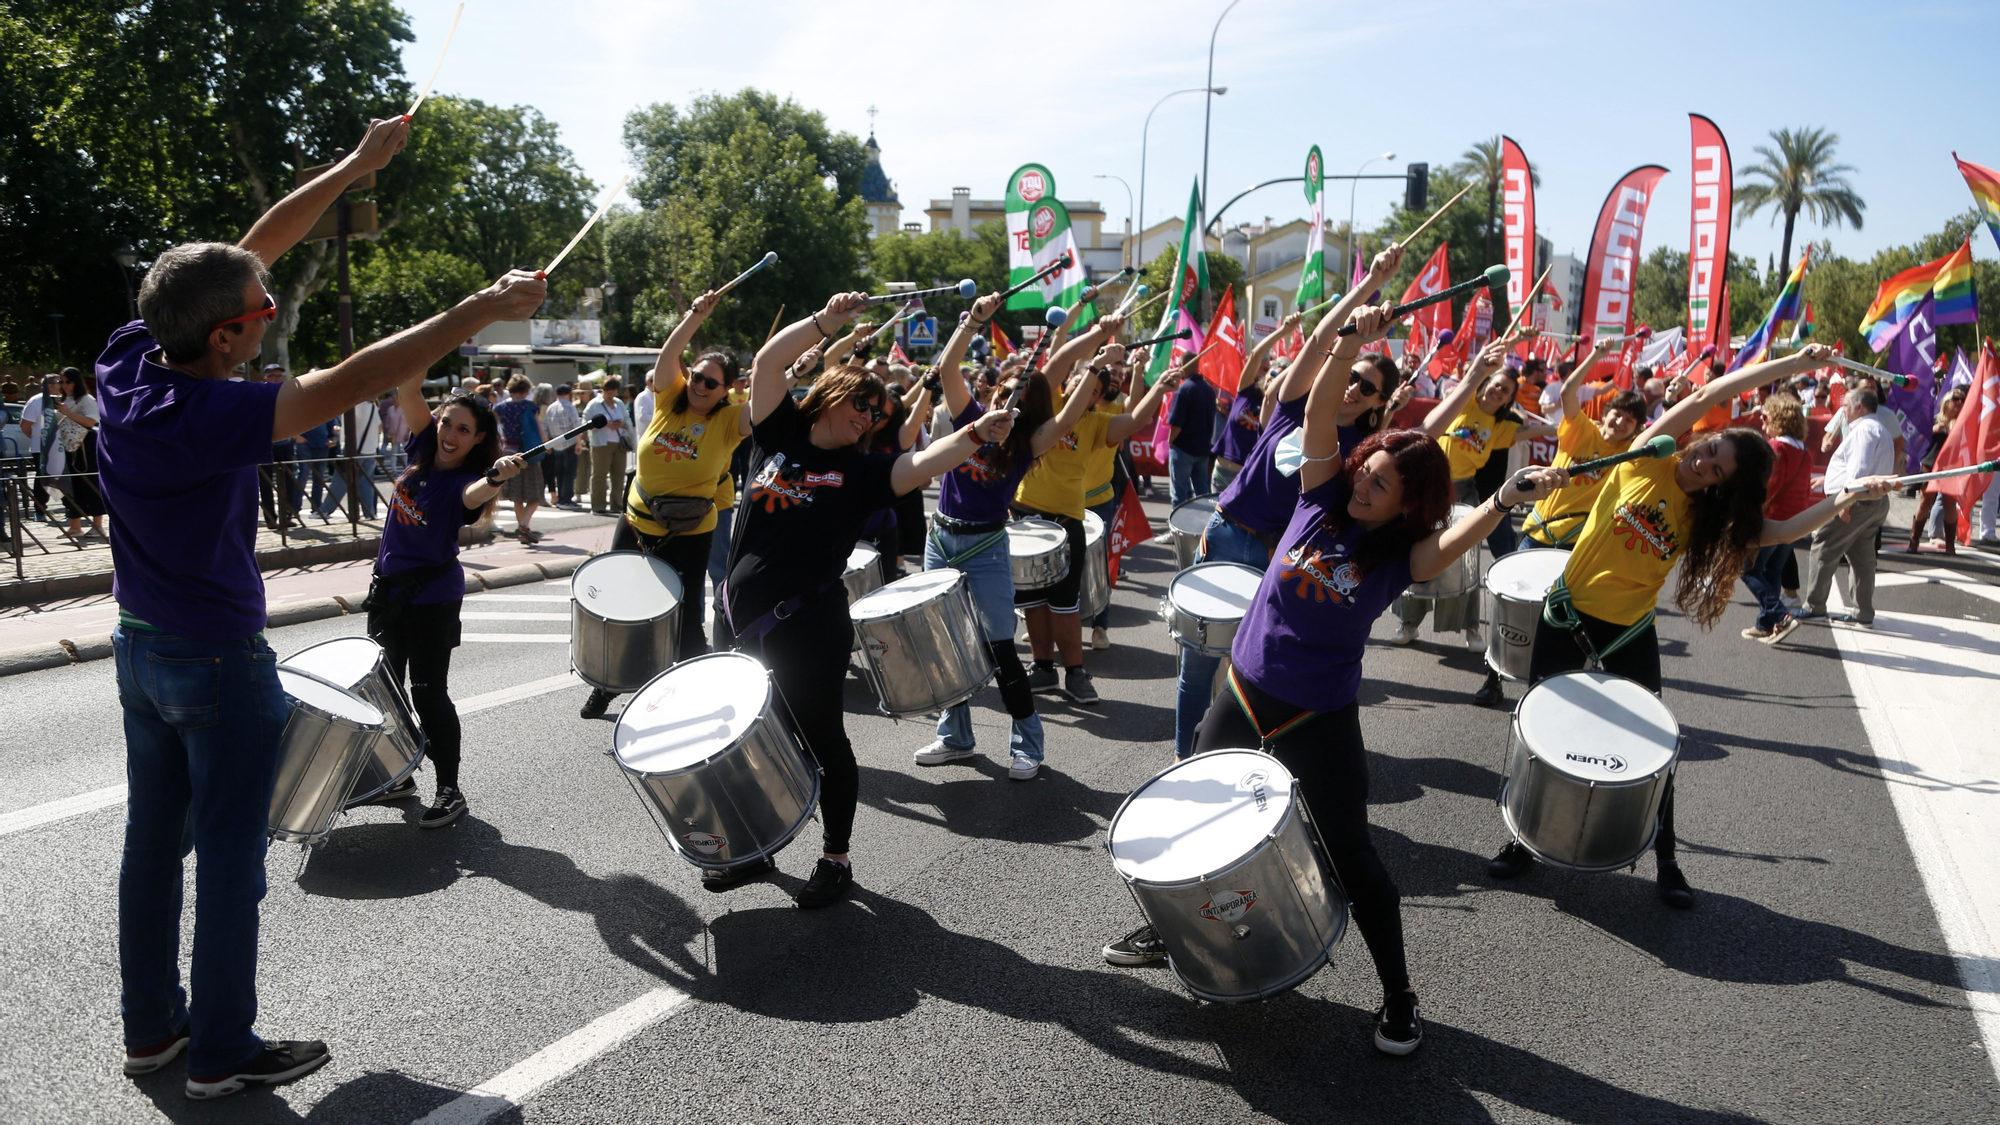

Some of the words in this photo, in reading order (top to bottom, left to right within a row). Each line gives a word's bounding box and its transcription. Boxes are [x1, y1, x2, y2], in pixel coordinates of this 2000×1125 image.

[1595, 186, 1647, 325] CCOO
[806, 473, 835, 482] CCOO
[1618, 506, 1670, 554] SAMBOREJO
[1565, 752, 1607, 767] LUEN
[1253, 782, 1269, 813] LUEN
